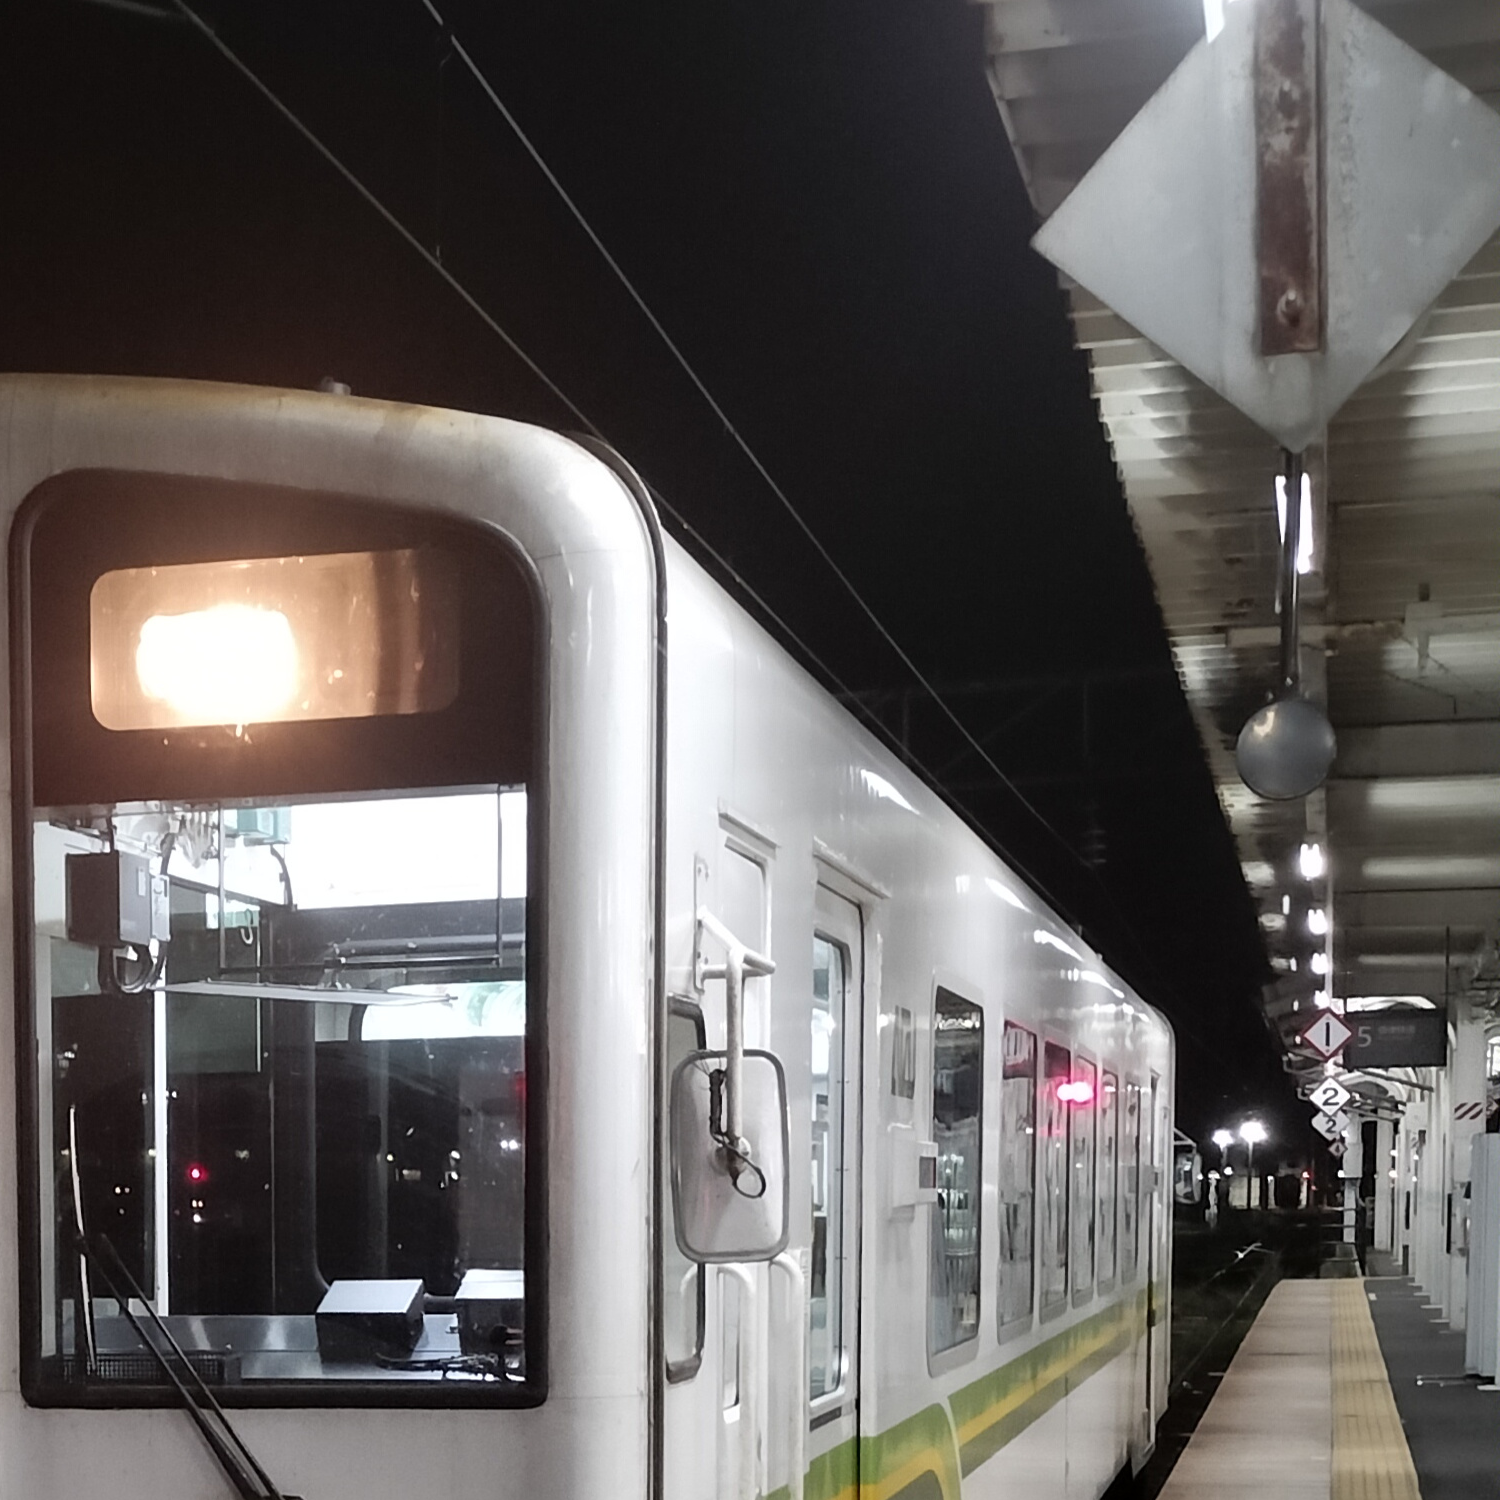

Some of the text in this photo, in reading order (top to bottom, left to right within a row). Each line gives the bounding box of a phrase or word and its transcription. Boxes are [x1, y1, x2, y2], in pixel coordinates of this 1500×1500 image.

[1357, 1026, 1372, 1047] 5
[1322, 1087, 1340, 1106] 2
[1325, 1119, 1336, 1133] 2
